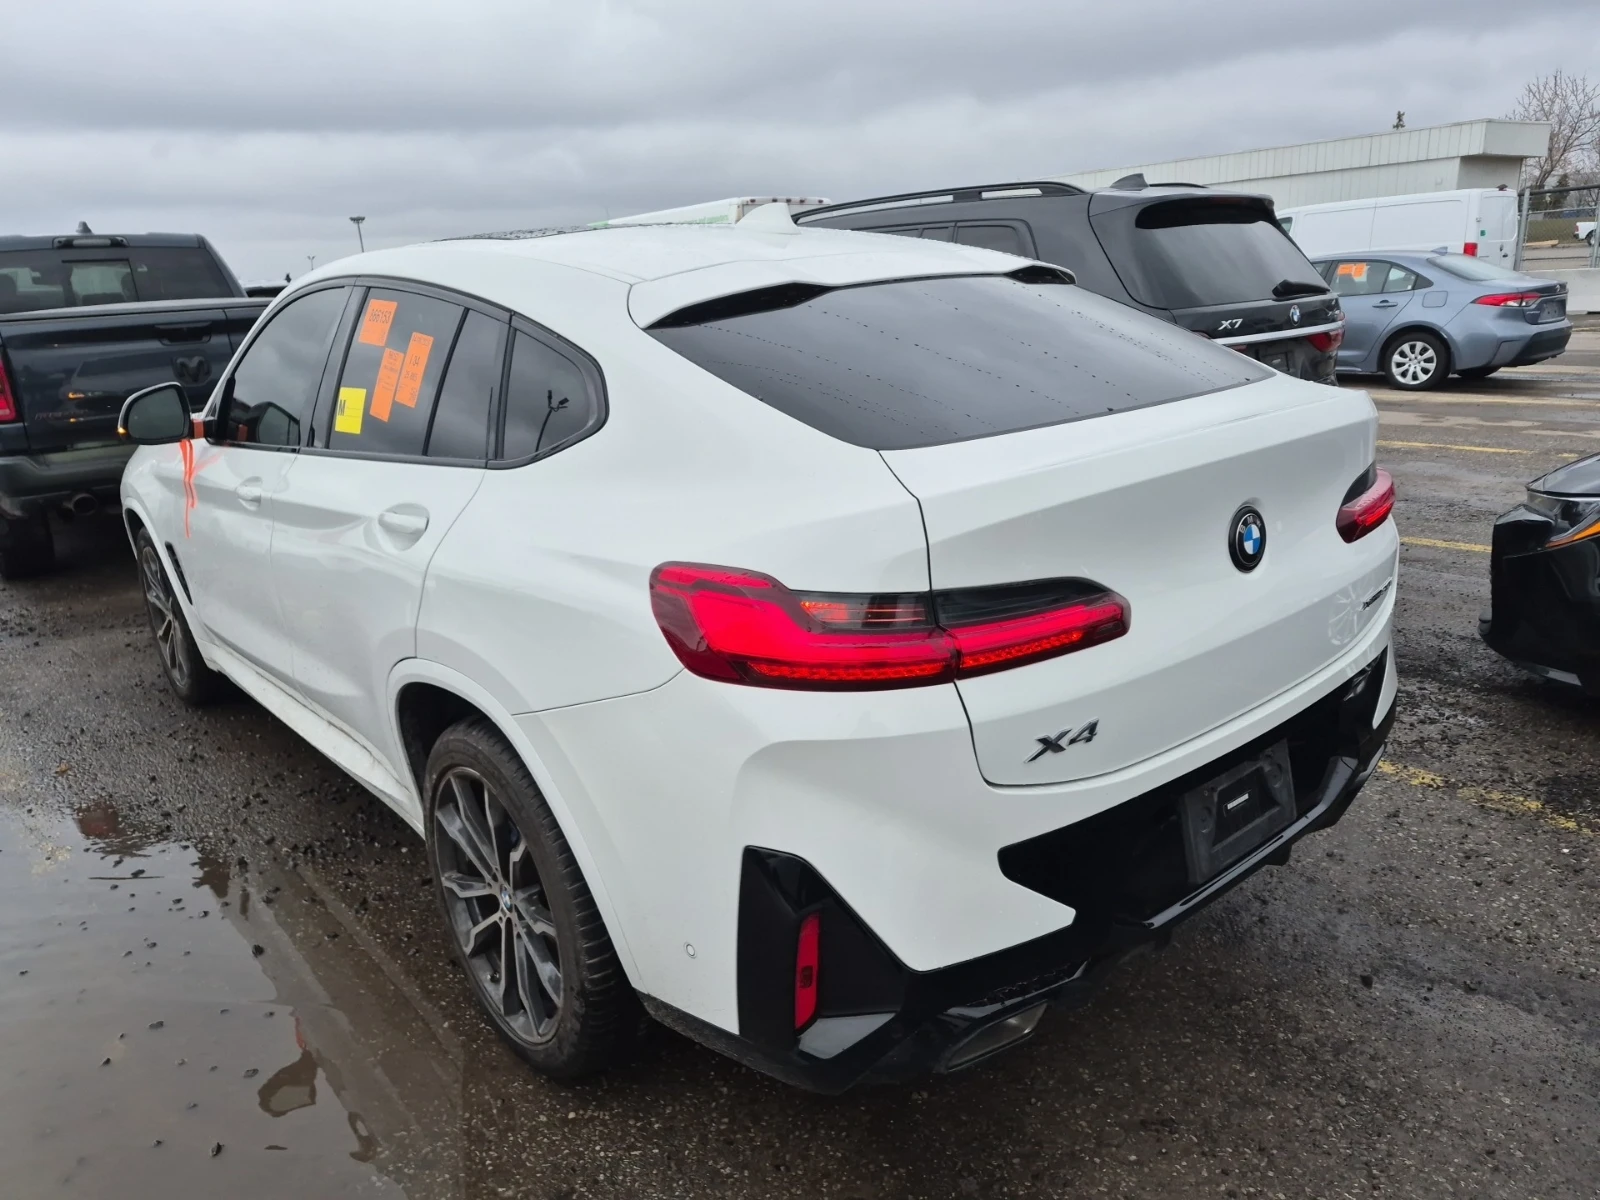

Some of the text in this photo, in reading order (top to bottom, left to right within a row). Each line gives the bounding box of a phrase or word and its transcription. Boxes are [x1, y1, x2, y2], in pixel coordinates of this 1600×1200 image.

[1217, 318, 1243, 331] X7
[1239, 515, 1262, 534] BMW
[1023, 717, 1100, 764] X4
